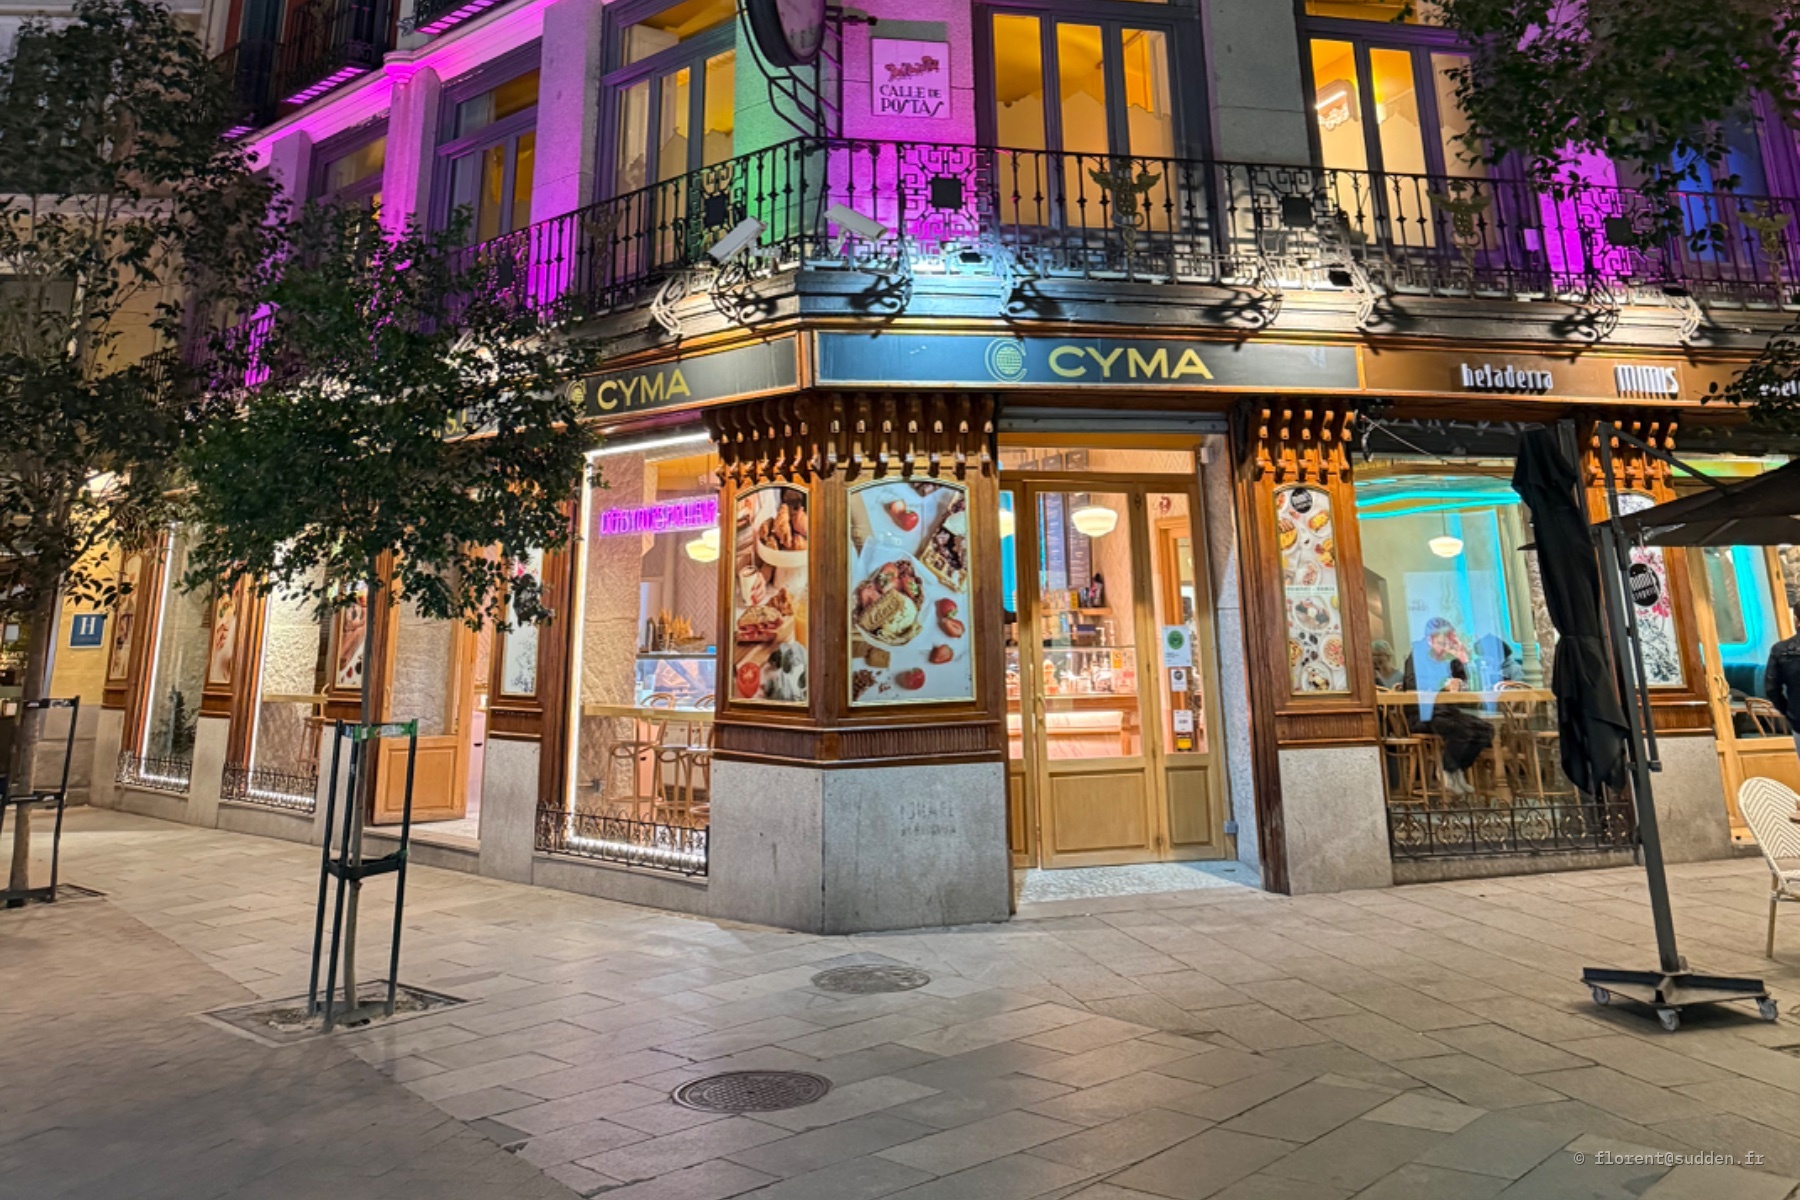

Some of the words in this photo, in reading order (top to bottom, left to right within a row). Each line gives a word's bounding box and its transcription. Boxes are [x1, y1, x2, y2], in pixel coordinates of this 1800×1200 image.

[879, 84, 926, 99] CALLE
[927, 88, 942, 99] DE
[880, 97, 944, 117] POSTAS
[1048, 345, 1214, 380] CYMA
[597, 368, 691, 410] CYMA
[80, 616, 97, 636] H
